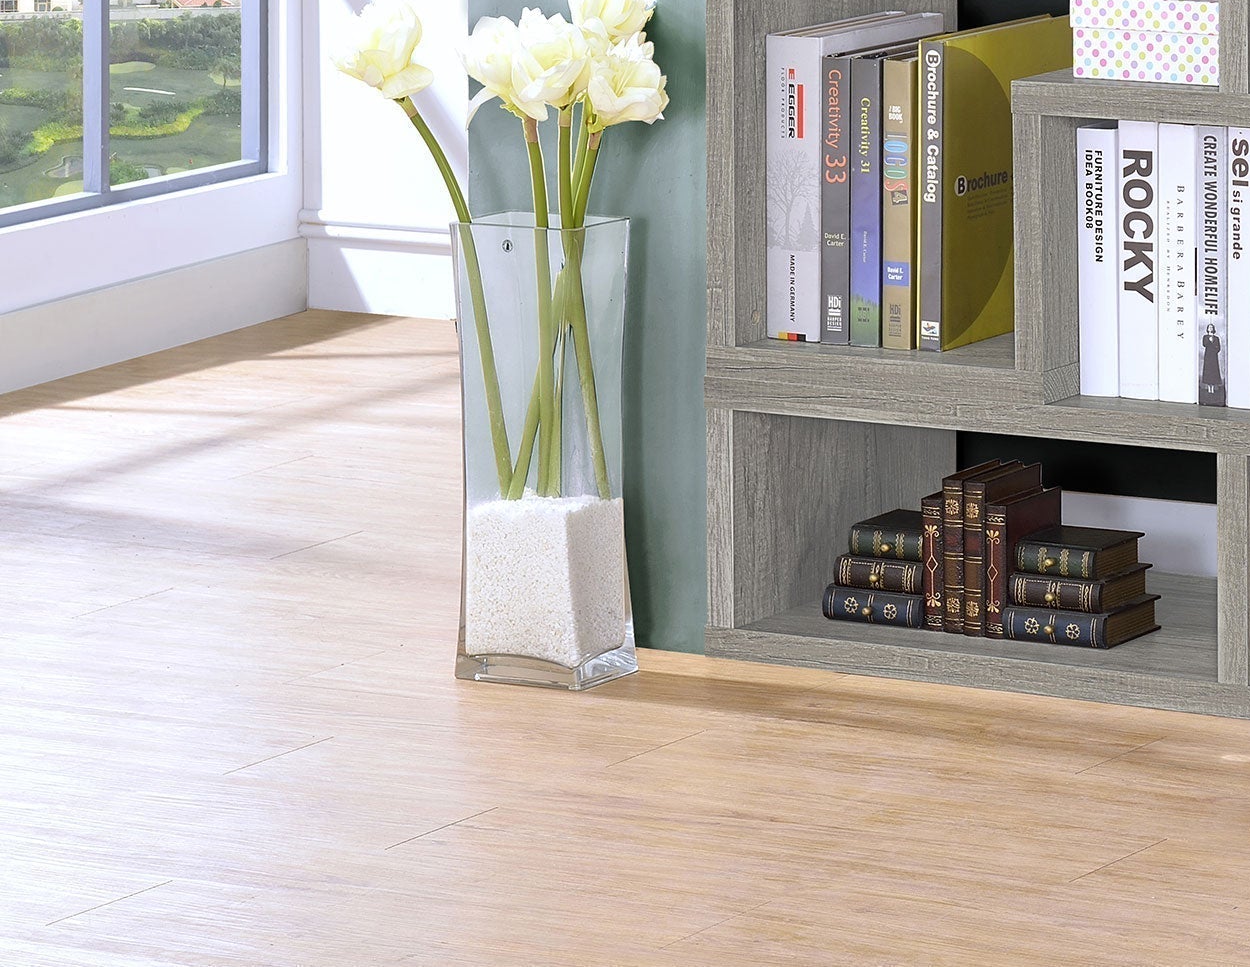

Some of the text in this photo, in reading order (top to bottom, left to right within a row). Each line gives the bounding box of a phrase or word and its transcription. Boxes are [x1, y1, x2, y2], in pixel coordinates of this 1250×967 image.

[825, 69, 847, 184] Creativity 33
[859, 97, 871, 174] Creativity 31
[923, 49, 941, 204] Brochure & Catalog
[956, 171, 1008, 196] Brochure
[1085, 149, 1093, 229] IDEA BOOK08
[1094, 150, 1103, 263] FURNITURE DESIGN
[1232, 190, 1243, 203] si
[824, 232, 840, 240] David
[1121, 149, 1154, 304] ROCKY
[1176, 185, 1185, 340] BARBERA BAREY
[1203, 135, 1218, 315] CREATE WONDERFUL HOMELIFE
[1230, 207, 1243, 260] grande
[789, 276, 796, 285] IN
